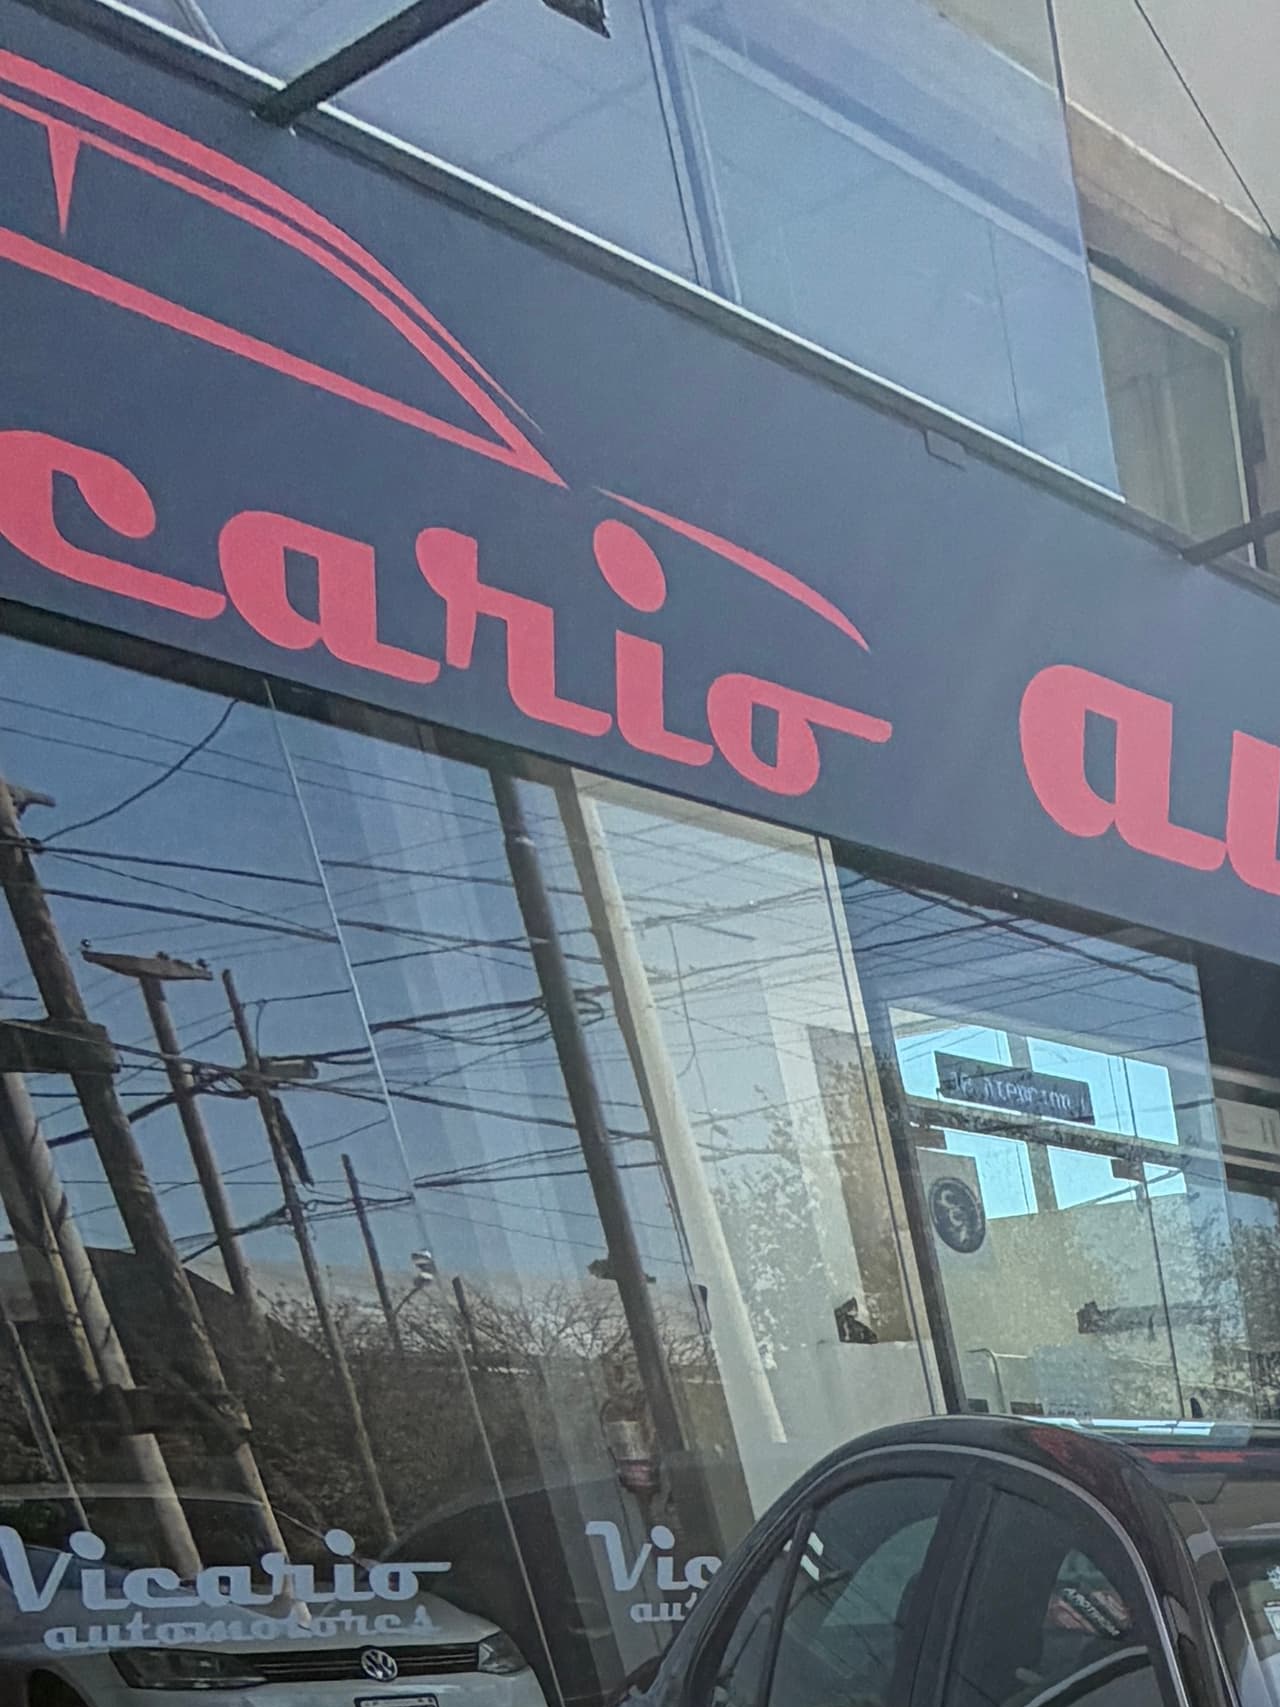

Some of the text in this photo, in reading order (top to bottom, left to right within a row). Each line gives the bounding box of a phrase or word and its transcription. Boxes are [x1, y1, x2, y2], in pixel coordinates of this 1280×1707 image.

[0, 1525, 451, 1612] Vicario
[585, 1521, 722, 1591] Vic
[44, 1605, 441, 1650] automotores
[630, 1592, 698, 1623] au
